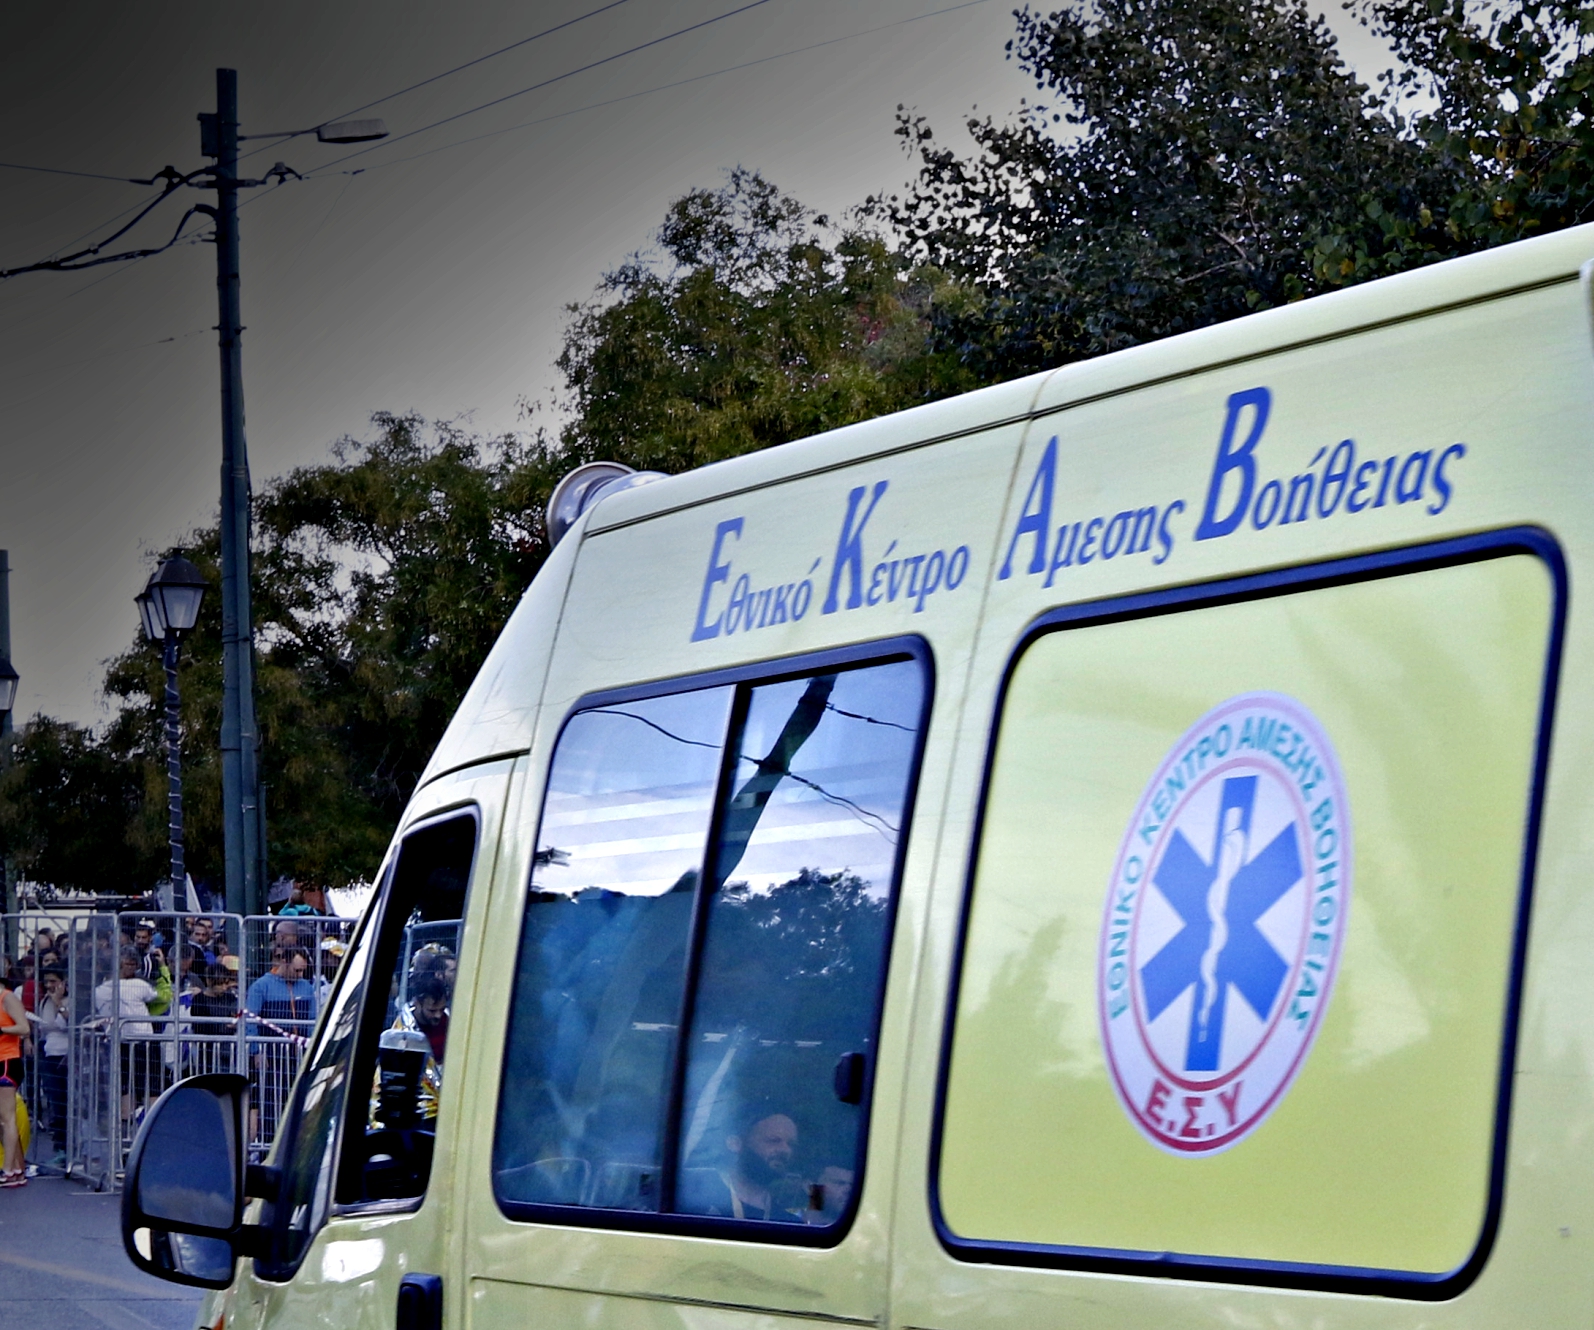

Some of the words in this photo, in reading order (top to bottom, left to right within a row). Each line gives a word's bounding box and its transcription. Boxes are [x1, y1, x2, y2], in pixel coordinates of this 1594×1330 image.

[690, 516, 822, 643] Εθνικό
[820, 479, 971, 615] Κέντρο
[996, 434, 1187, 588] Αμεσης
[1194, 385, 1468, 542] Βοήθειας
